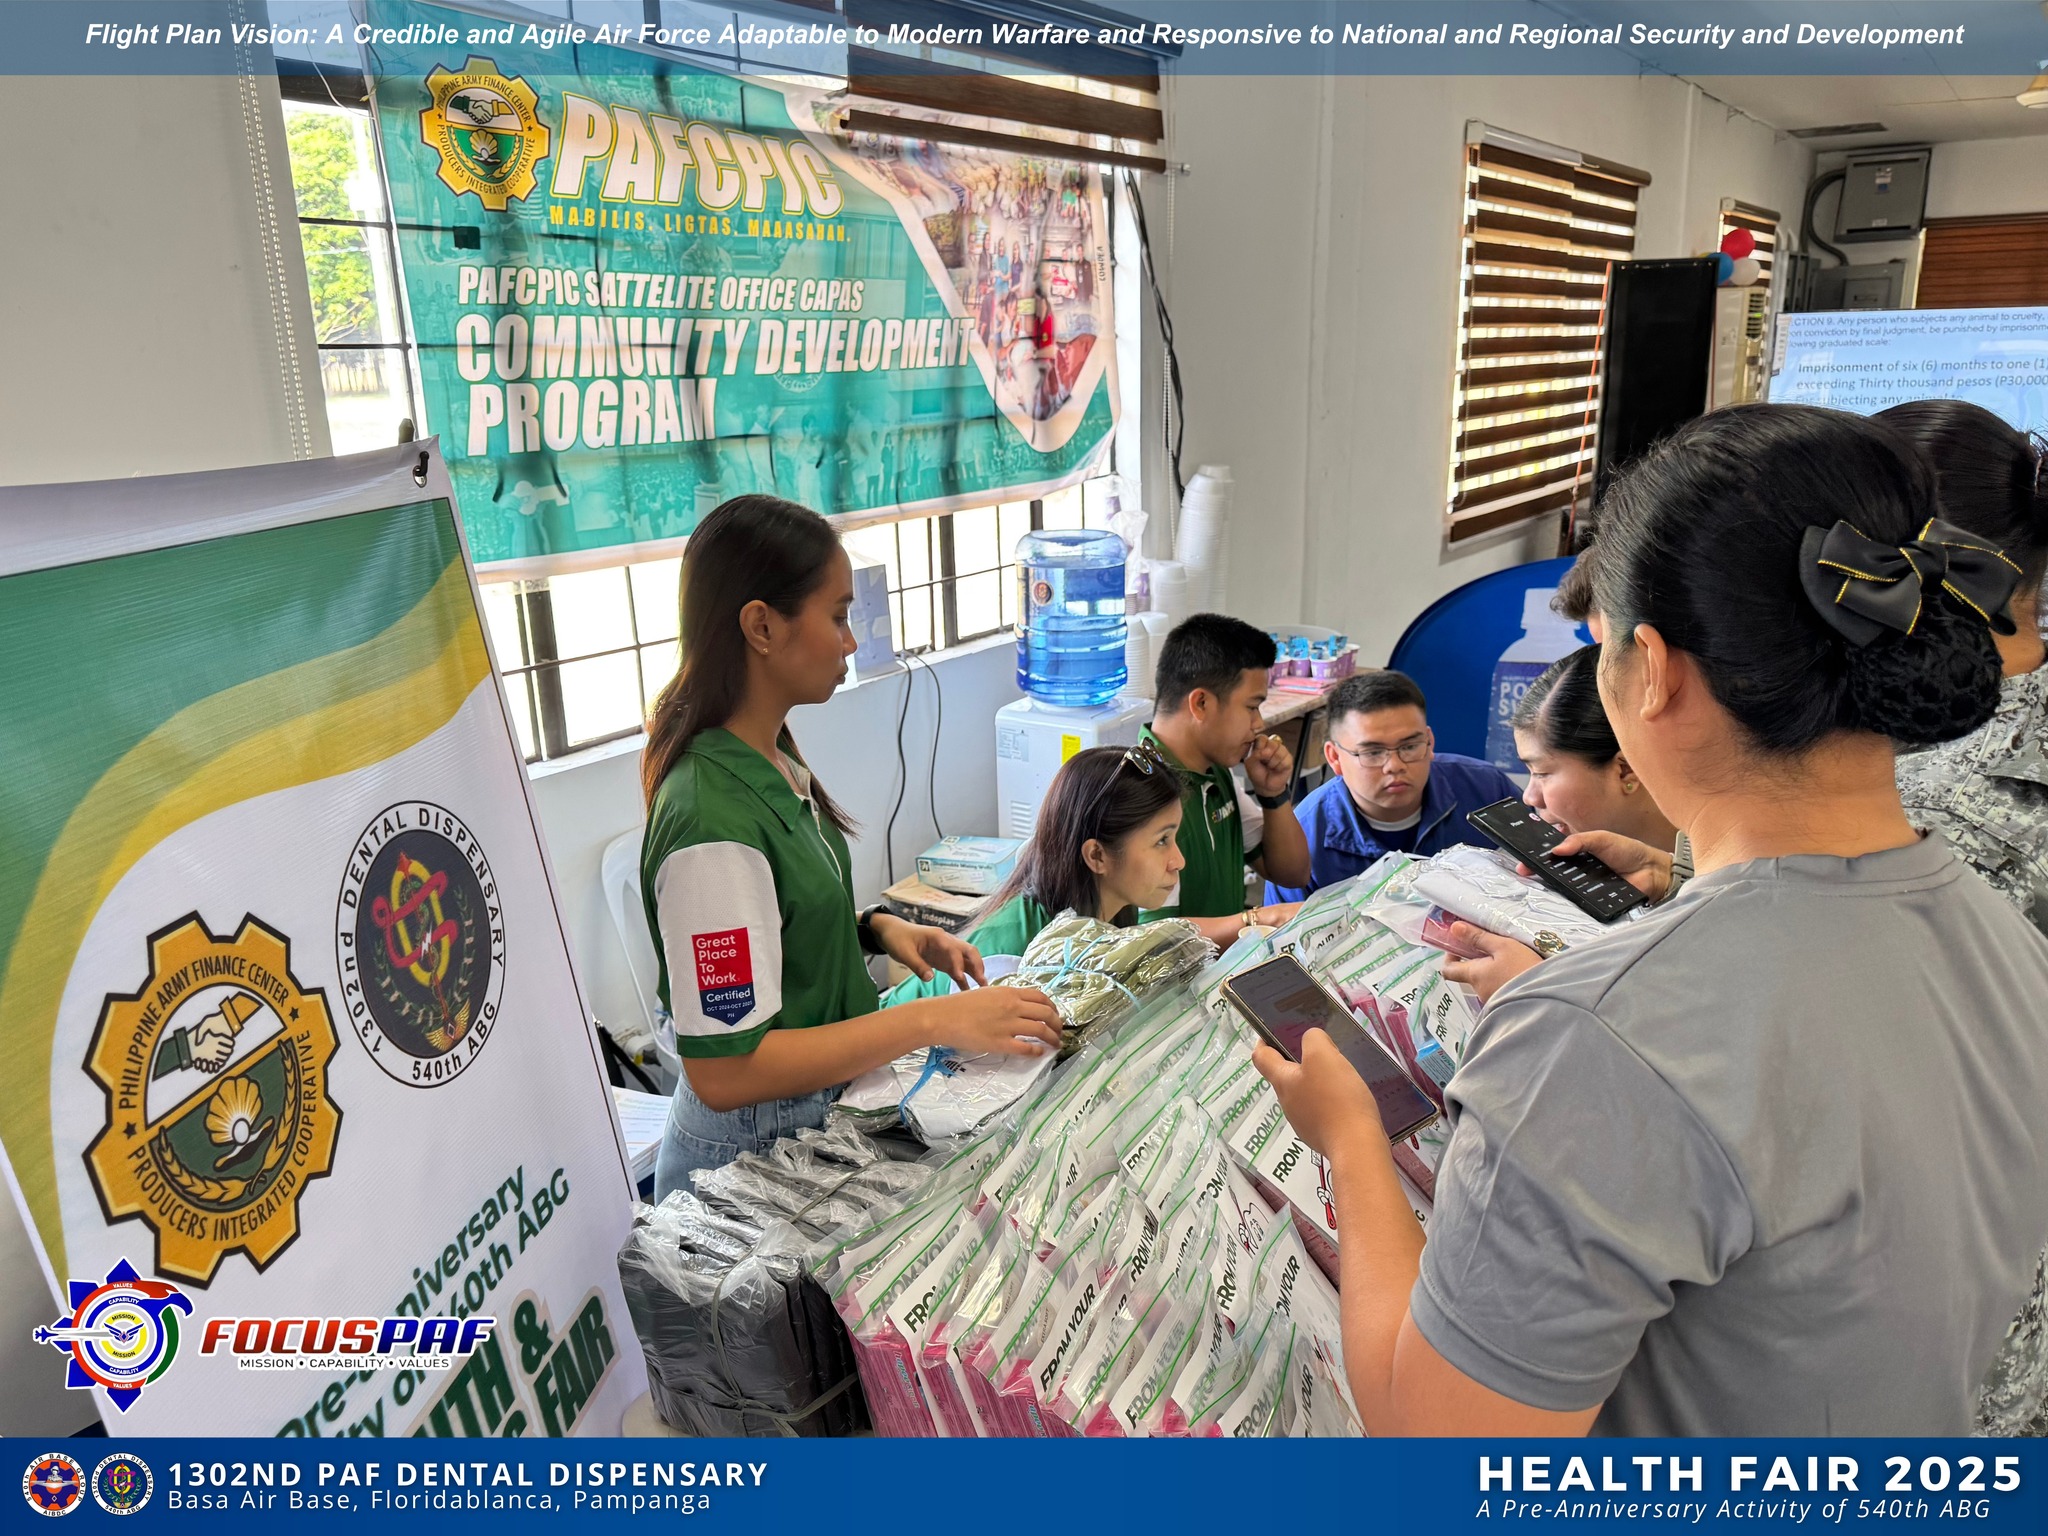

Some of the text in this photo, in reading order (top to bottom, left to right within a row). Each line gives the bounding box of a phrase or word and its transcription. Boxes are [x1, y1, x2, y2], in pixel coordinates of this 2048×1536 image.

[462, 75, 482, 85] ARMY
[484, 76, 513, 99] FINANCE
[512, 95, 532, 123] CENTER
[437, 124, 536, 195] PRODUCERS INTEGRATED COOPERATIVE
[549, 89, 846, 220] PAFCPIC
[549, 205, 852, 243] MABILIS. LIGTAS. MAAASAHAN.
[458, 265, 864, 313] PAFCPIC SATTELITE OFFICE CAPAS
[1792, 317, 1824, 326] CTION
[1837, 317, 1854, 327] Any
[1856, 316, 1887, 326] person
[1890, 315, 1909, 323] who
[1910, 315, 1947, 325] subjects
[1949, 314, 1966, 324] any
[1968, 313, 1999, 321] animal
[2001, 312, 2010, 321] to
[2011, 312, 2046, 322] cruelty,
[1804, 328, 1848, 337] conviction
[1850, 328, 1860, 337] by
[1862, 327, 1881, 336] final
[1882, 325, 1927, 336] judgment,
[1929, 325, 1940, 333] be
[1943, 324, 1984, 335] punished
[1986, 323, 1998, 333] by
[455, 313, 977, 382] COMMUNITY DEVELOPMENT
[1819, 339, 1891, 349] graduated scale:
[1796, 379, 1856, 391] exceeding
[1860, 378, 1893, 390] Thirty
[1897, 377, 1953, 388] thousand
[1957, 378, 1992, 388] pesos
[1798, 363, 1884, 375] Imprisonment
[1887, 362, 1900, 372] of
[1902, 361, 1918, 371] six
[1921, 360, 1938, 373] (6)
[1941, 359, 1988, 371] months
[1991, 360, 2004, 370] to
[2007, 360, 2031, 370] one
[466, 377, 718, 457] PROGRAM
[343, 808, 503, 968] DENTAL DISPENSARY
[696, 934, 736, 949] Great
[698, 948, 737, 961] Place
[699, 962, 715, 974] To
[701, 972, 737, 987] Work
[340, 932, 383, 1054] 1302nd
[706, 987, 751, 1003] Certified
[119, 955, 290, 1110] PHILIPPINE ARMY FINANCE CENTER
[412, 1001, 496, 1082] 540th ABG
[1221, 1091, 1256, 1128] FROM
[127, 1030, 318, 1242] PRODUCERS INTEGRATED COOPERATIVE
[1244, 1116, 1273, 1155] FROM
[1272, 1141, 1304, 1183] FROM
[517, 1168, 569, 1255] ABG
[1281, 1254, 1302, 1298] YOUR
[1040, 1329, 1073, 1392] FROM
[1068, 1283, 1097, 1333] YOUR
[534, 1295, 615, 1437] FAIR
